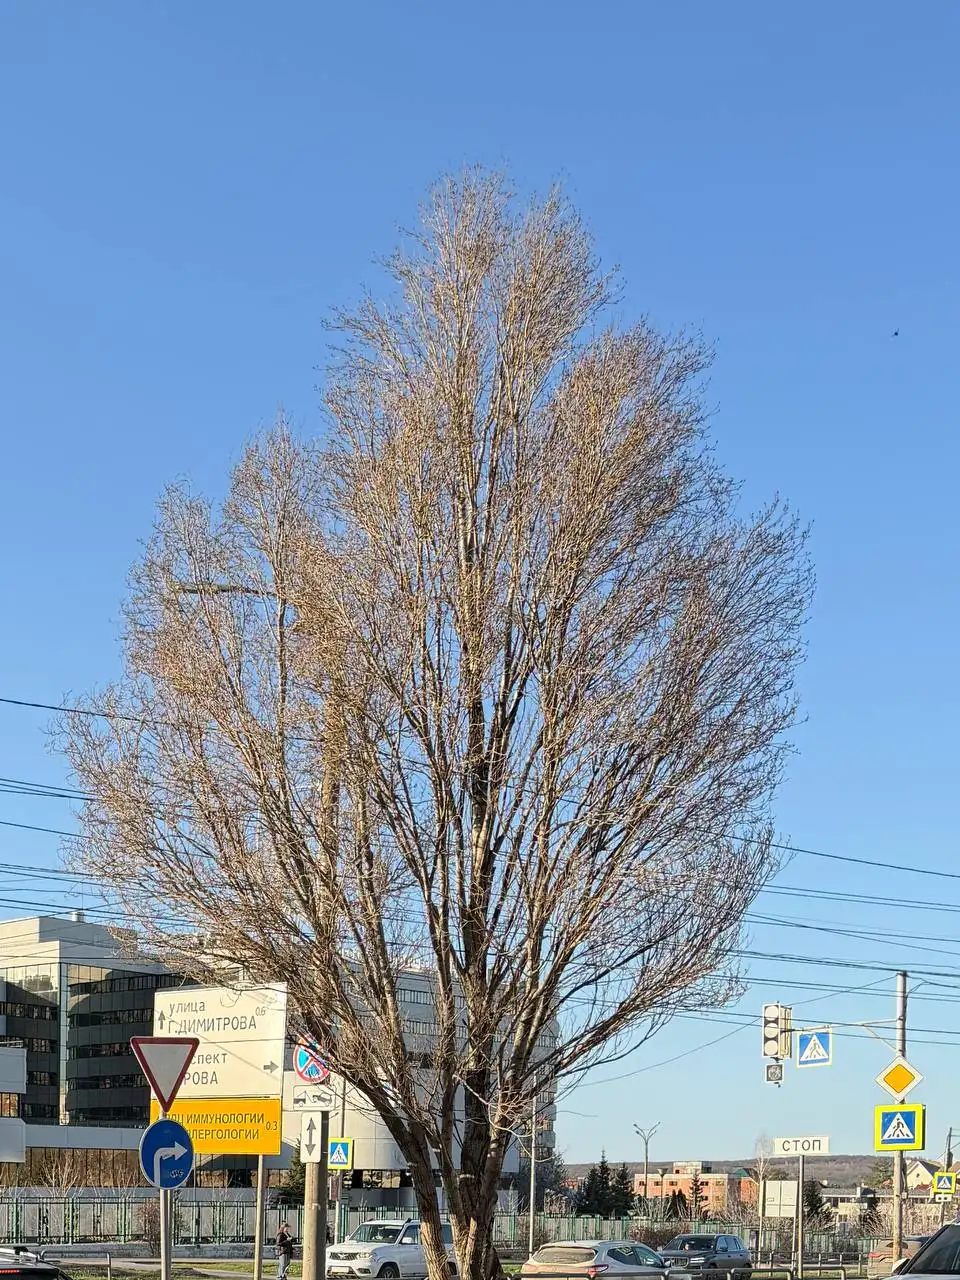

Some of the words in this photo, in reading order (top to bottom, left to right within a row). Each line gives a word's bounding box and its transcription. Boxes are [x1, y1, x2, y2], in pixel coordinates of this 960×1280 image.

[169, 1001, 206, 1017] улица
[191, 1053, 228, 1065] спект
[184, 1071, 218, 1085] РОВА
[186, 1113, 264, 1124] ИММУНОЛОГИИ
[265, 1121, 278, 1131] 0.3
[189, 1129, 259, 1140] ЛЕРГОЛОГИИ
[782, 1139, 822, 1151] СТОП
